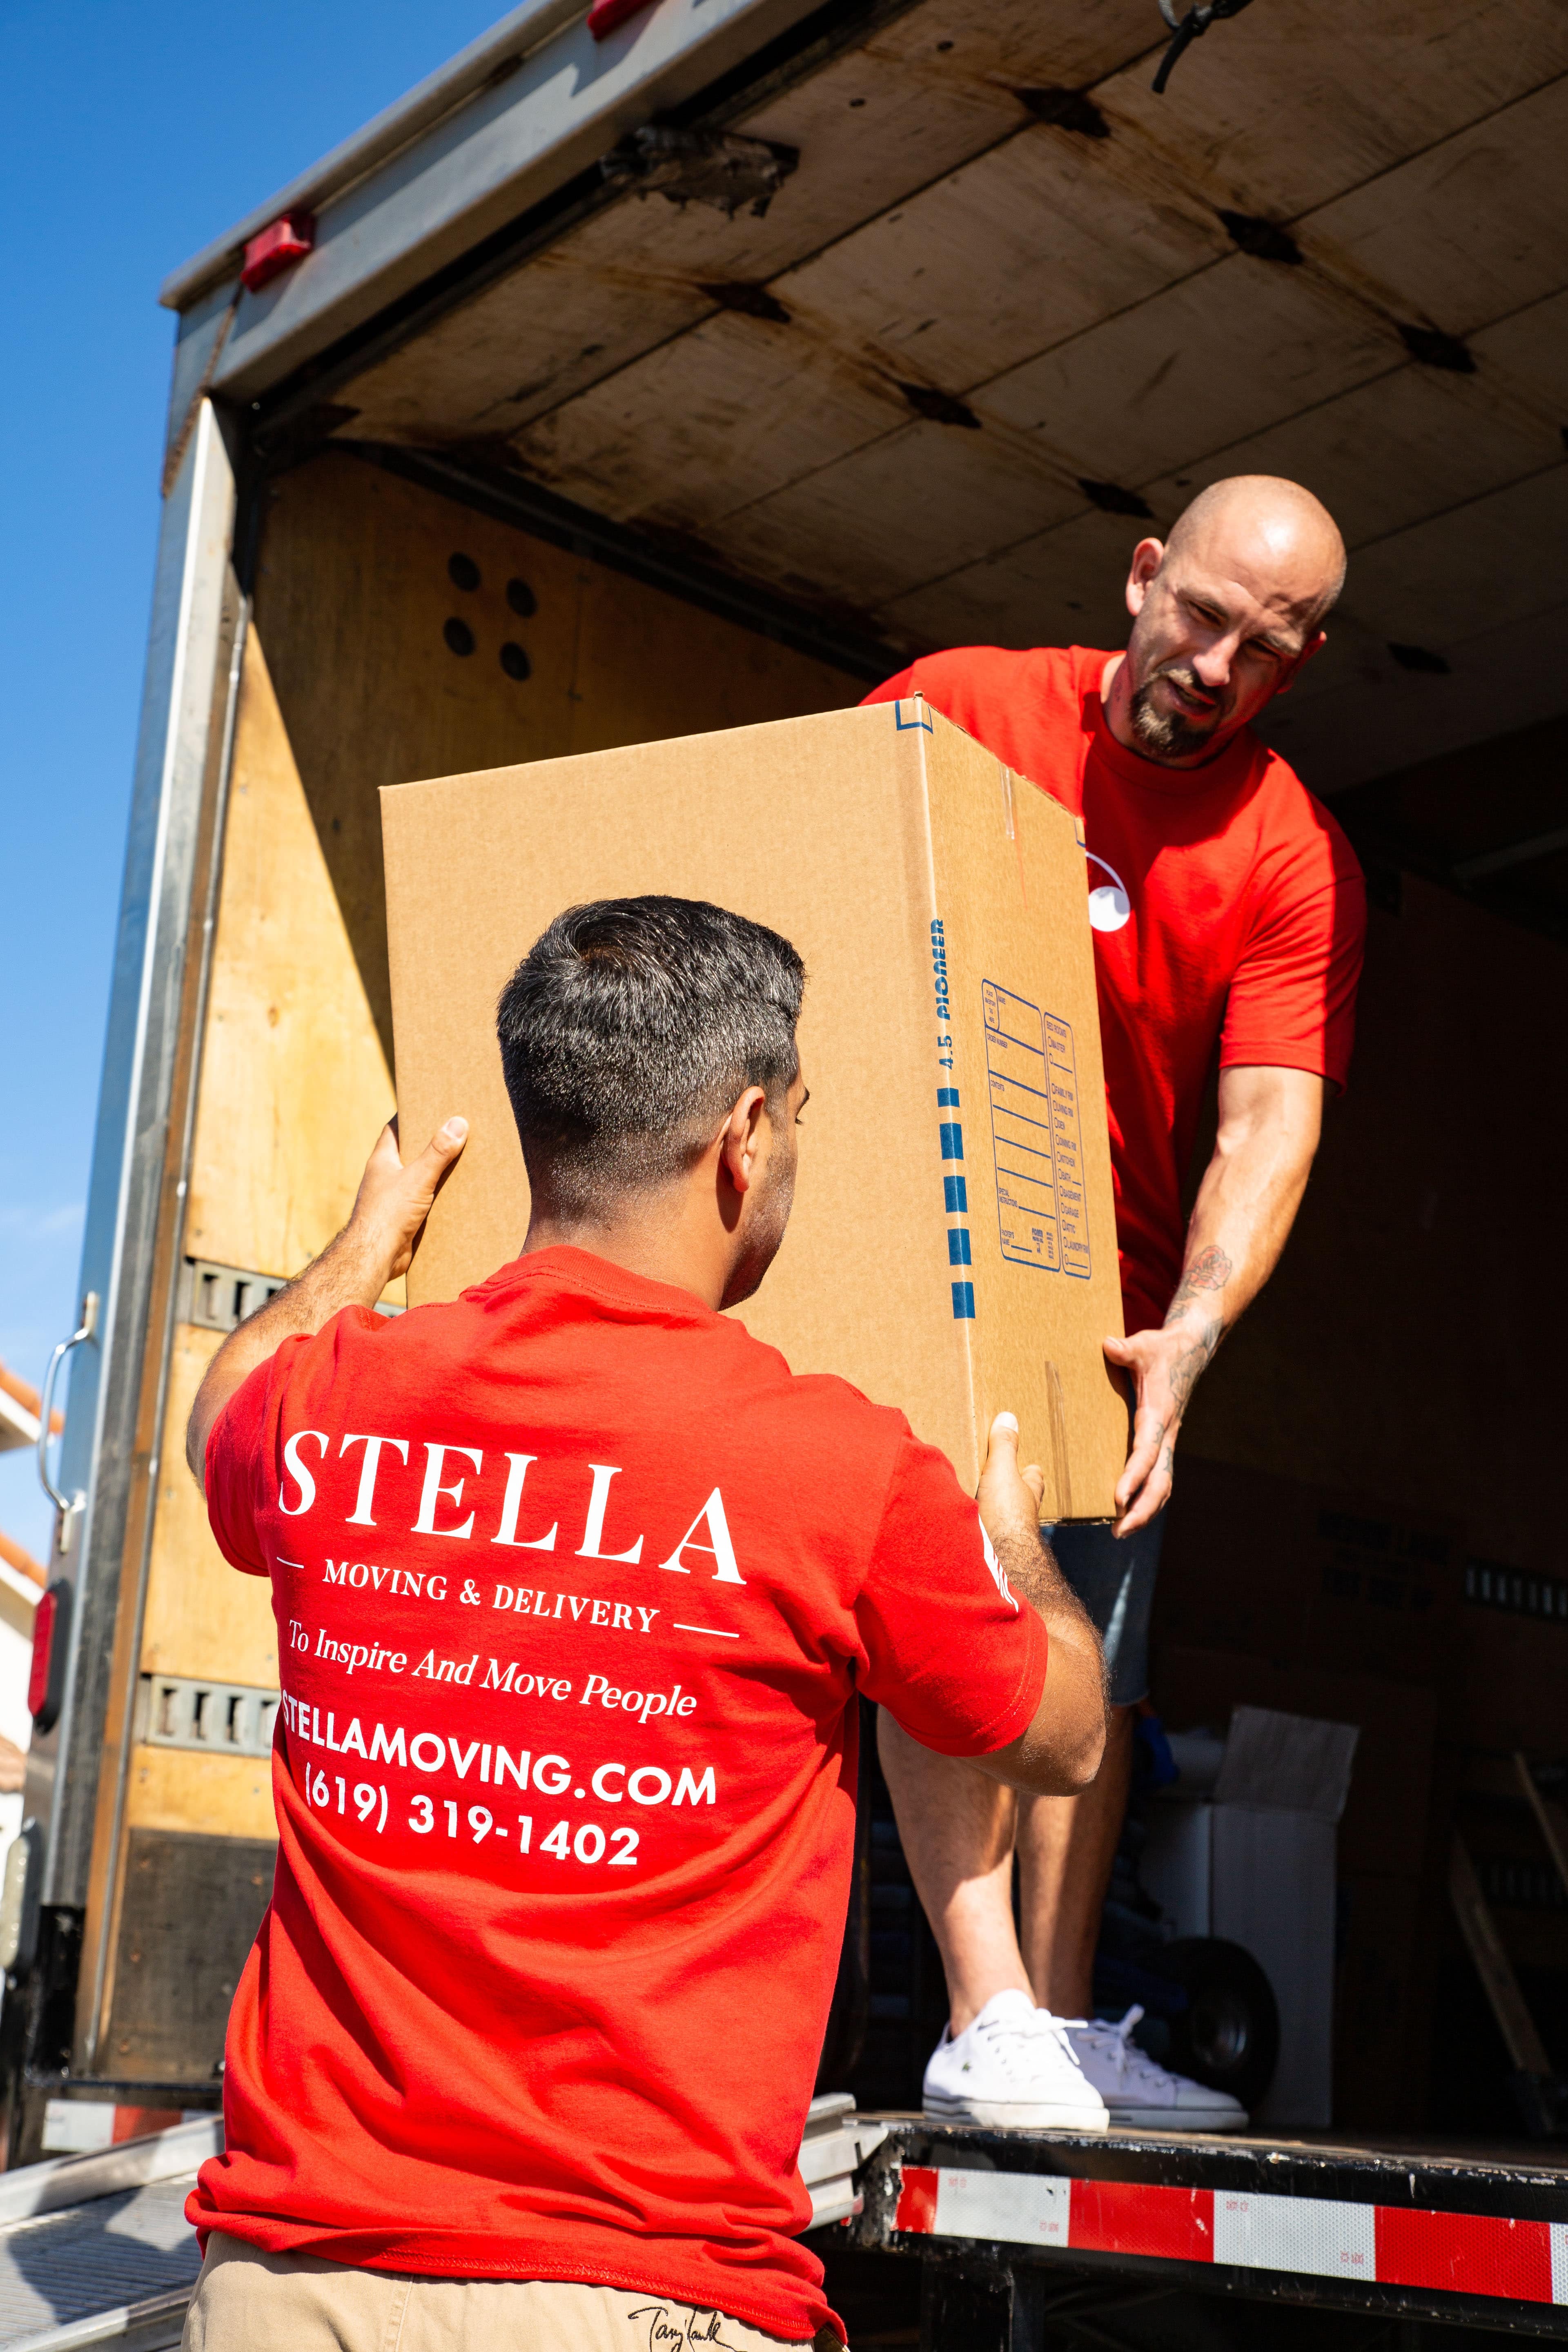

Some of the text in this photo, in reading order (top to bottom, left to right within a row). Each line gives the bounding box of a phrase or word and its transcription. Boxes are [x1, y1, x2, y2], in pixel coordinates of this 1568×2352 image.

[930, 918, 953, 1070] 4.5 PIONEER
[998, 995, 1006, 1005] NAME
[984, 997, 996, 1007] INVENTORY
[987, 1033, 1008, 1049] ORDER NUMBER
[1051, 1039, 1065, 1054] MASTER
[990, 1080, 1005, 1091] CONTENTS
[1055, 1086, 1067, 1098] FAMILY
[1056, 1103, 1067, 1115] LIVING
[1057, 1119, 1065, 1130] DEN
[1059, 1137, 1071, 1149] DINING
[1060, 1154, 1075, 1167] KITCHEN
[1062, 1171, 1071, 1182] BATH
[998, 1187, 1009, 1197] SPECIAL
[1063, 1188, 1081, 1202] BASEMENT
[999, 1196, 1018, 1208] INSTRUCTIONS
[1065, 1205, 1079, 1218] GARAGE
[1001, 1229, 1015, 1239] PACKER'S
[1066, 1223, 1076, 1234] ATTIC
[1002, 1238, 1010, 1246] NAME
[1067, 1240, 1083, 1252] LAUNDRY
[278, 1430, 747, 1585] STELLA
[322, 1559, 660, 1633] MOVING & DELIVERY
[289, 1619, 697, 1724] To Inspire And Move People
[282, 1689, 716, 1806] STELLAMOVING.COM
[305, 1762, 639, 1865] (619) 319-1402
